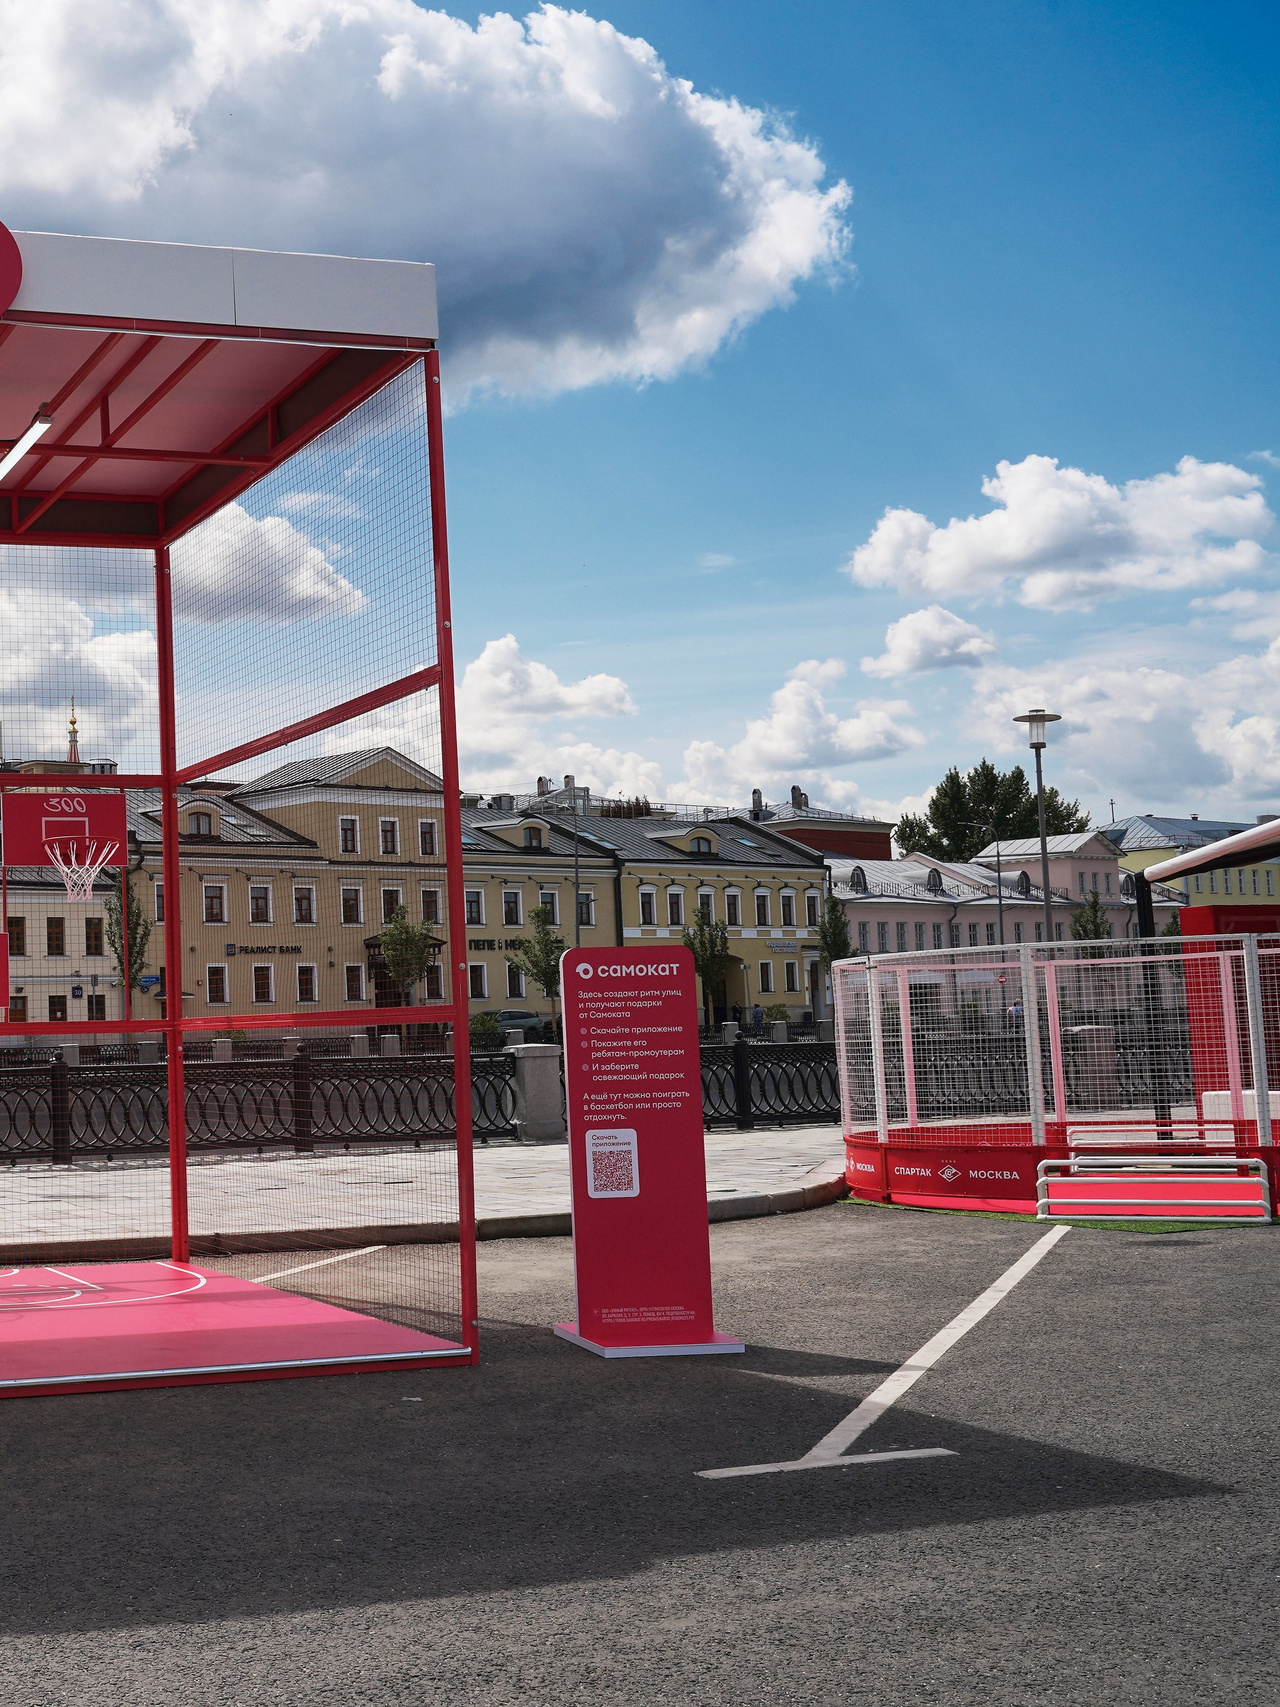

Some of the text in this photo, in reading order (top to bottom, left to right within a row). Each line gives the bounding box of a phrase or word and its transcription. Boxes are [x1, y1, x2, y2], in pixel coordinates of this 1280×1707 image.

[43, 797, 87, 813] 300
[239, 945, 302, 954] РЕАЛИСТ БАНК
[468, 939, 496, 951] ПЕПЕ
[597, 963, 680, 978] самокат
[578, 989, 682, 999] Здесь создают ритм улиц
[586, 1001, 625, 1010] получают
[627, 1000, 662, 1008] подарки
[589, 1010, 631, 1018] Самоката
[590, 1026, 630, 1035] Скачайте
[631, 1025, 683, 1034] приложение
[591, 1040, 632, 1048] Покажите
[633, 1039, 647, 1047] его
[591, 1049, 685, 1059] ребятам-промоутерам
[592, 1063, 599, 1071] И
[601, 1063, 639, 1071] заберите
[592, 1071, 685, 1081] освежающий подарок
[591, 1092, 608, 1100] ещё
[609, 1093, 621, 1101] тут
[652, 1091, 690, 1099] поиграть
[590, 1102, 634, 1110] баскетбол
[635, 1101, 651, 1109] или
[652, 1101, 682, 1110] просто
[583, 1113, 627, 1121] отдохнуть.
[591, 1140, 632, 1148] приложение
[894, 1166, 1020, 1180] СПАРТАК МОСКВА
